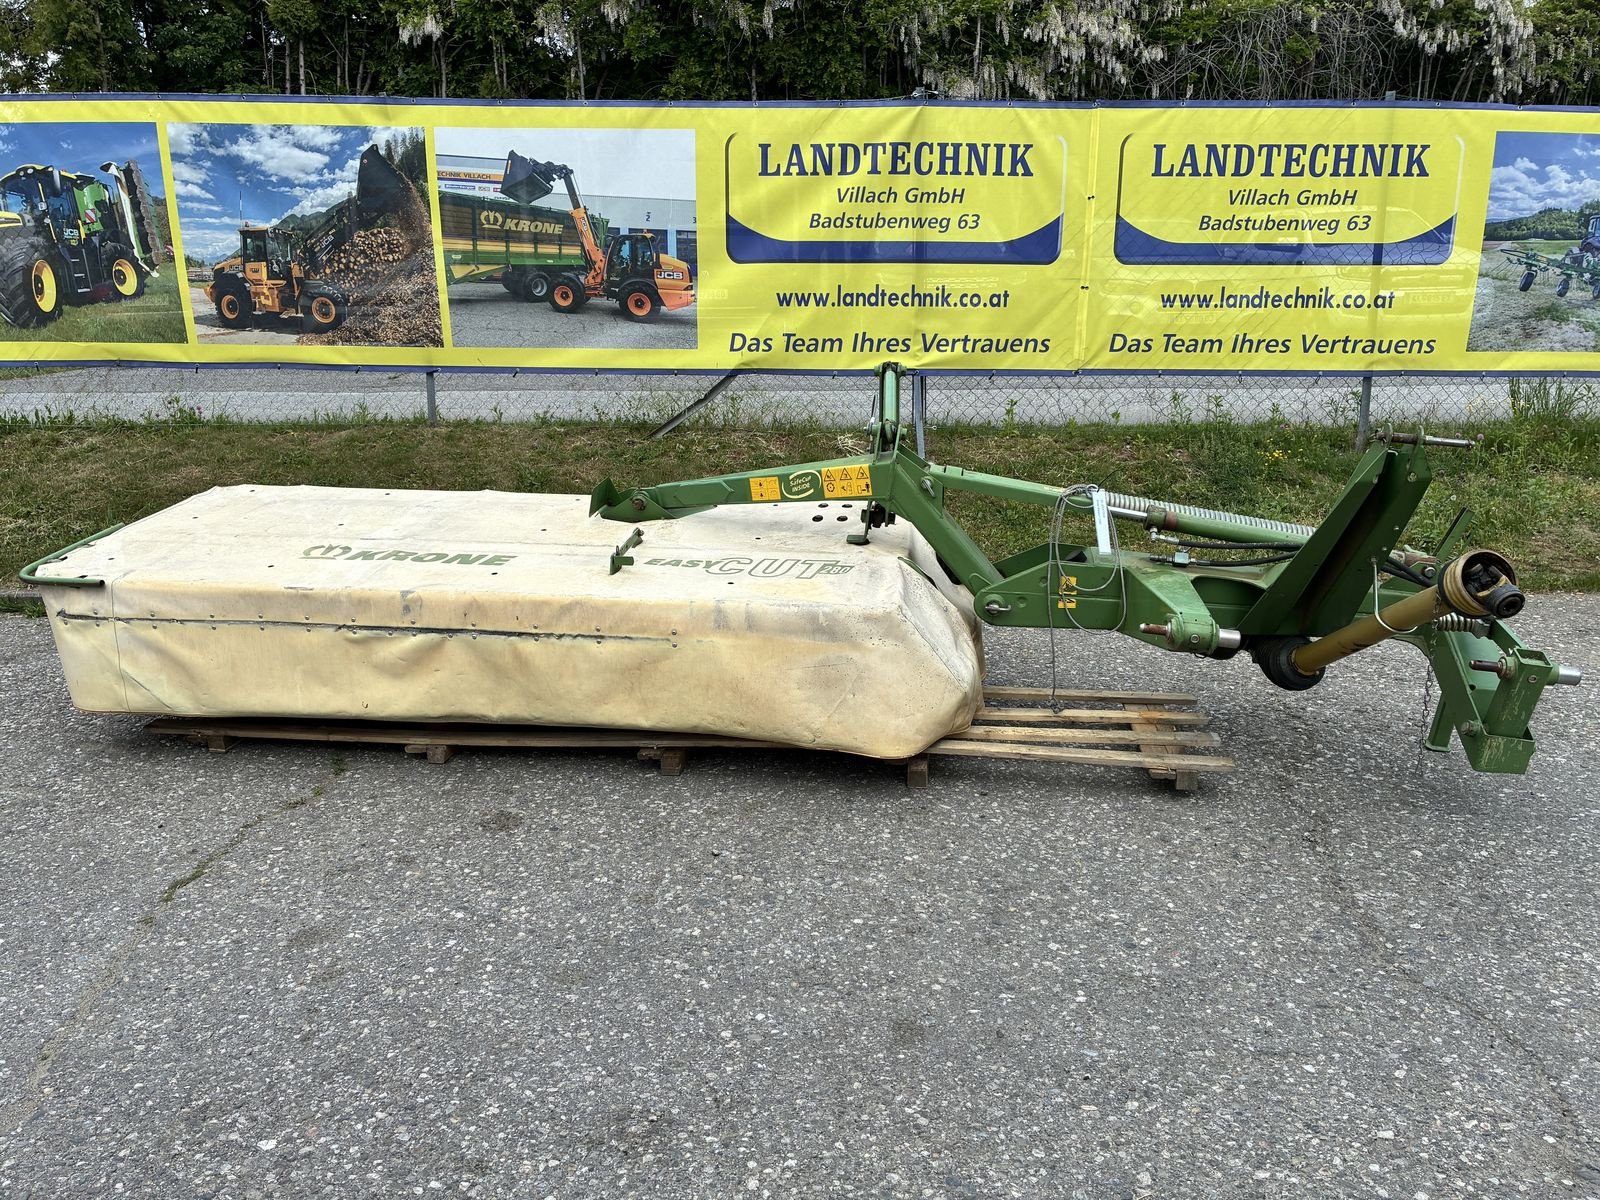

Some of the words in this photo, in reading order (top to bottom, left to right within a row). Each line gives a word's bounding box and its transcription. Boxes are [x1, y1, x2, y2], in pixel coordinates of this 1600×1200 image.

[758, 141, 1034, 177] LANDTECHNIK
[1151, 143, 1431, 178] LANDTECHNIK
[463, 172, 491, 180] VILLACH
[837, 187, 898, 203] Villach
[905, 187, 966, 204] GmbH
[1228, 188, 1290, 206] Villach
[1296, 188, 1358, 206] GmbH
[63, 228, 79, 236] JCB
[503, 218, 564, 234] KRONE
[809, 212, 951, 234] Badstubenweg
[957, 213, 981, 230] 63
[1198, 214, 1341, 236] Badstubenweg
[1346, 215, 1372, 231] 63
[657, 271, 683, 279] JCB
[775, 284, 1010, 308] www.landtechnik.co.at
[1160, 286, 1396, 309] www.landtechnik.co.at
[729, 332, 773, 353] Das
[782, 332, 843, 353] Team
[852, 331, 912, 353] Ihres
[921, 332, 1051, 354] Vertrauens
[1108, 333, 1154, 353] Das
[1162, 333, 1223, 354] Team
[1231, 332, 1292, 354] Ihres
[1301, 334, 1437, 355] Vertrauens
[343, 550, 519, 566] KRONE
